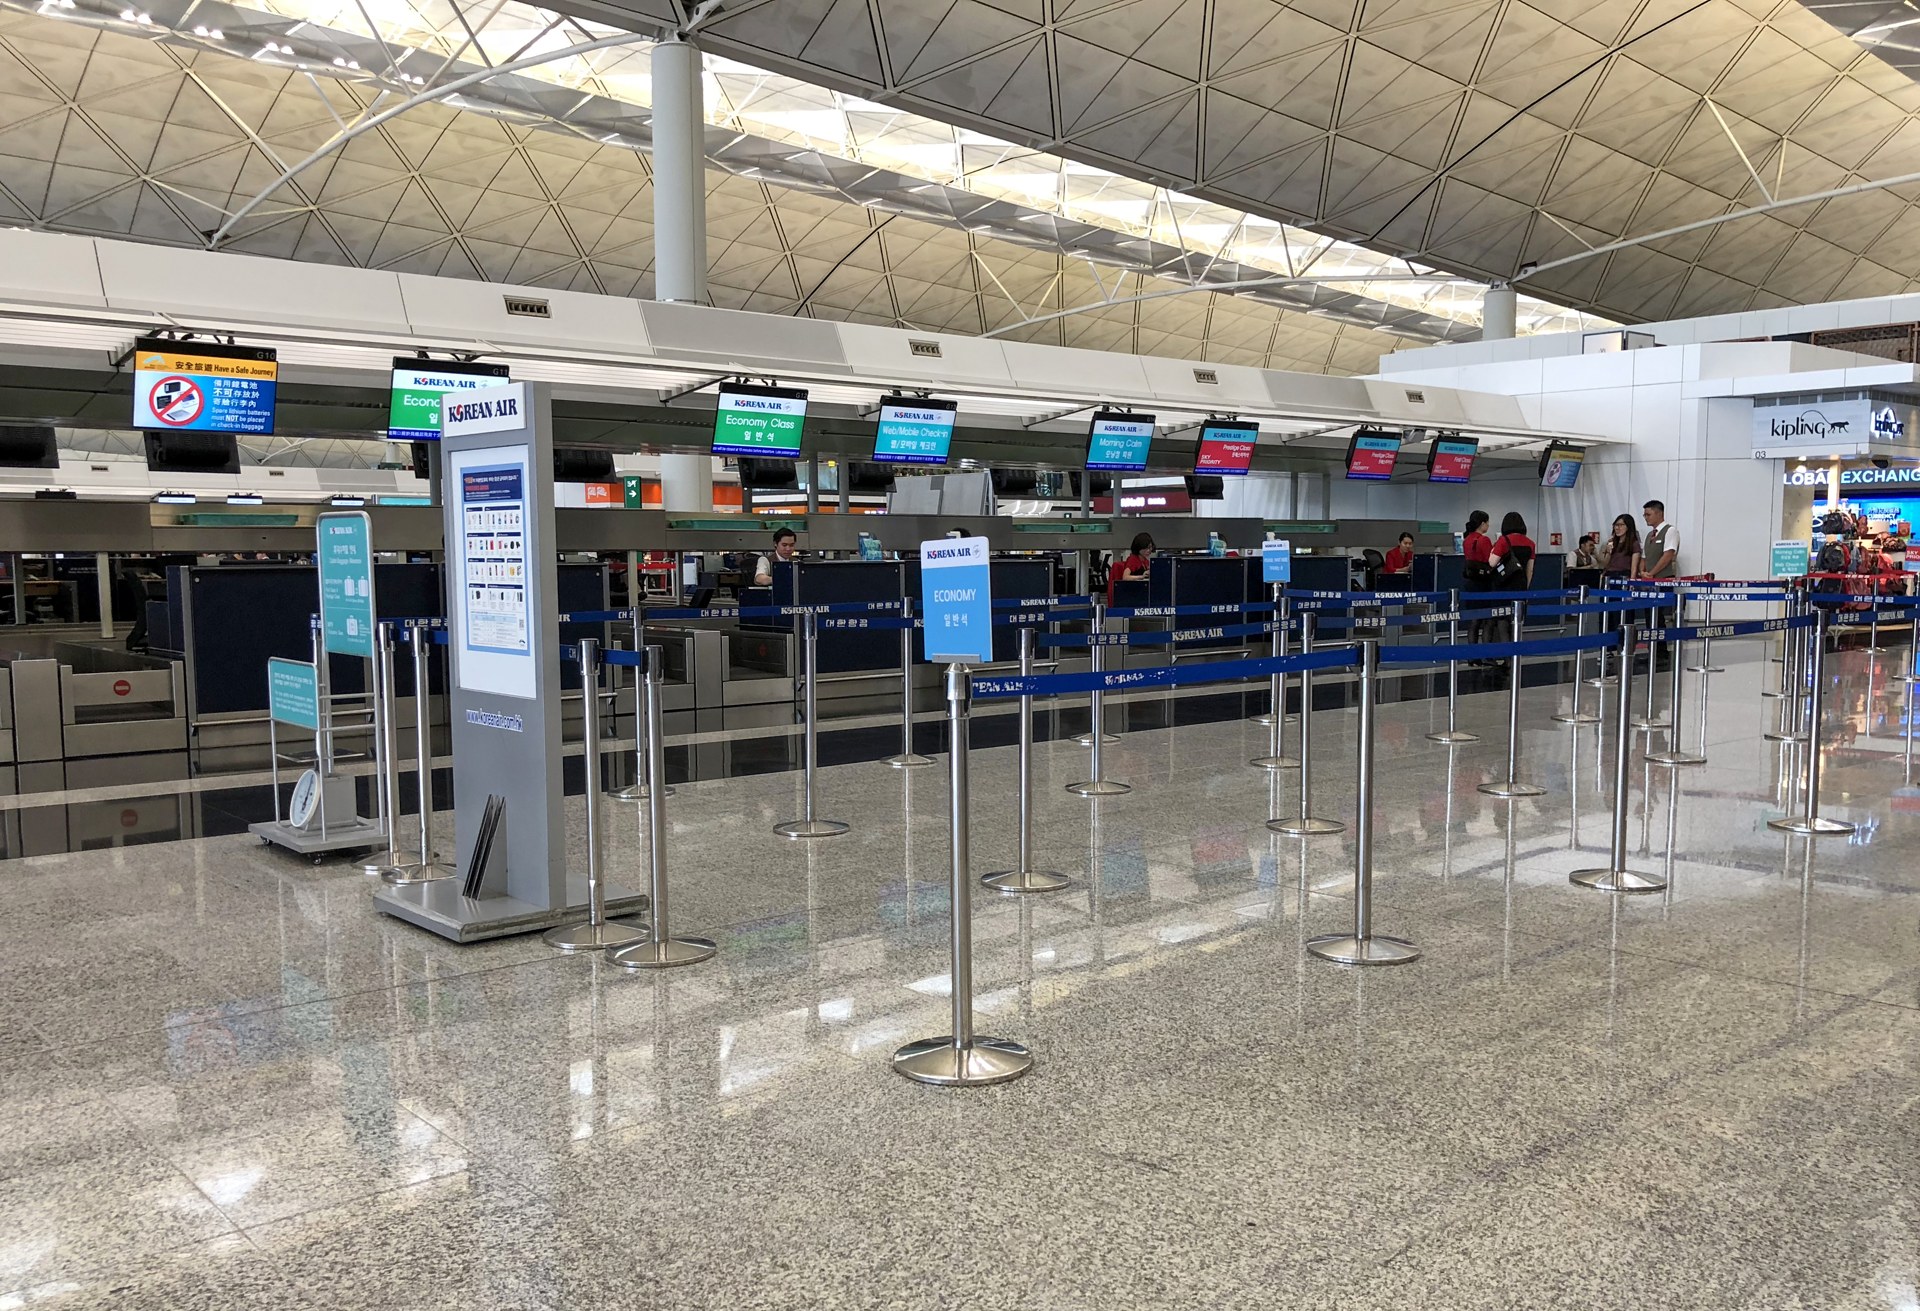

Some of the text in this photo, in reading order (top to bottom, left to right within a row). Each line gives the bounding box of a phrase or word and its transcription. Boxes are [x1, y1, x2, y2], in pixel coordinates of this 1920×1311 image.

[256, 352, 276, 360] G10
[214, 364, 230, 372] Have
[236, 366, 249, 374] Safe
[250, 367, 274, 377] Journey
[493, 368, 508, 376] G11
[414, 377, 455, 388] KOREAN
[404, 395, 440, 407] Econo
[796, 392, 808, 400] G12
[448, 398, 518, 423] KOREAN AIR
[734, 400, 782, 410] KOREAN AIR
[247, 416, 266, 424] placed
[894, 412, 920, 420] KOREAN
[726, 415, 794, 429] Economy Class
[882, 425, 920, 436] Web/Mobile
[1771, 416, 1825, 440] kipling
[1100, 438, 1142, 448] Morning Calm
[1755, 450, 1767, 460] 03
[1784, 469, 1920, 486] LOBA EXCHANG
[927, 547, 971, 560] KOREAN AIR
[934, 588, 976, 602] ECONOMY
[781, 606, 813, 615] KOREAN
[815, 605, 830, 613] AIR
[1134, 608, 1162, 616] KOREAN
[1162, 607, 1176, 615] AIR
[558, 614, 570, 622] IR
[1421, 614, 1448, 623] KOREAN
[1448, 612, 1460, 621] AIR
[1172, 630, 1206, 641] KOREAN
[1207, 628, 1223, 638] AIR
[1697, 627, 1722, 638] KOREAN
[1722, 626, 1734, 635] AIR
